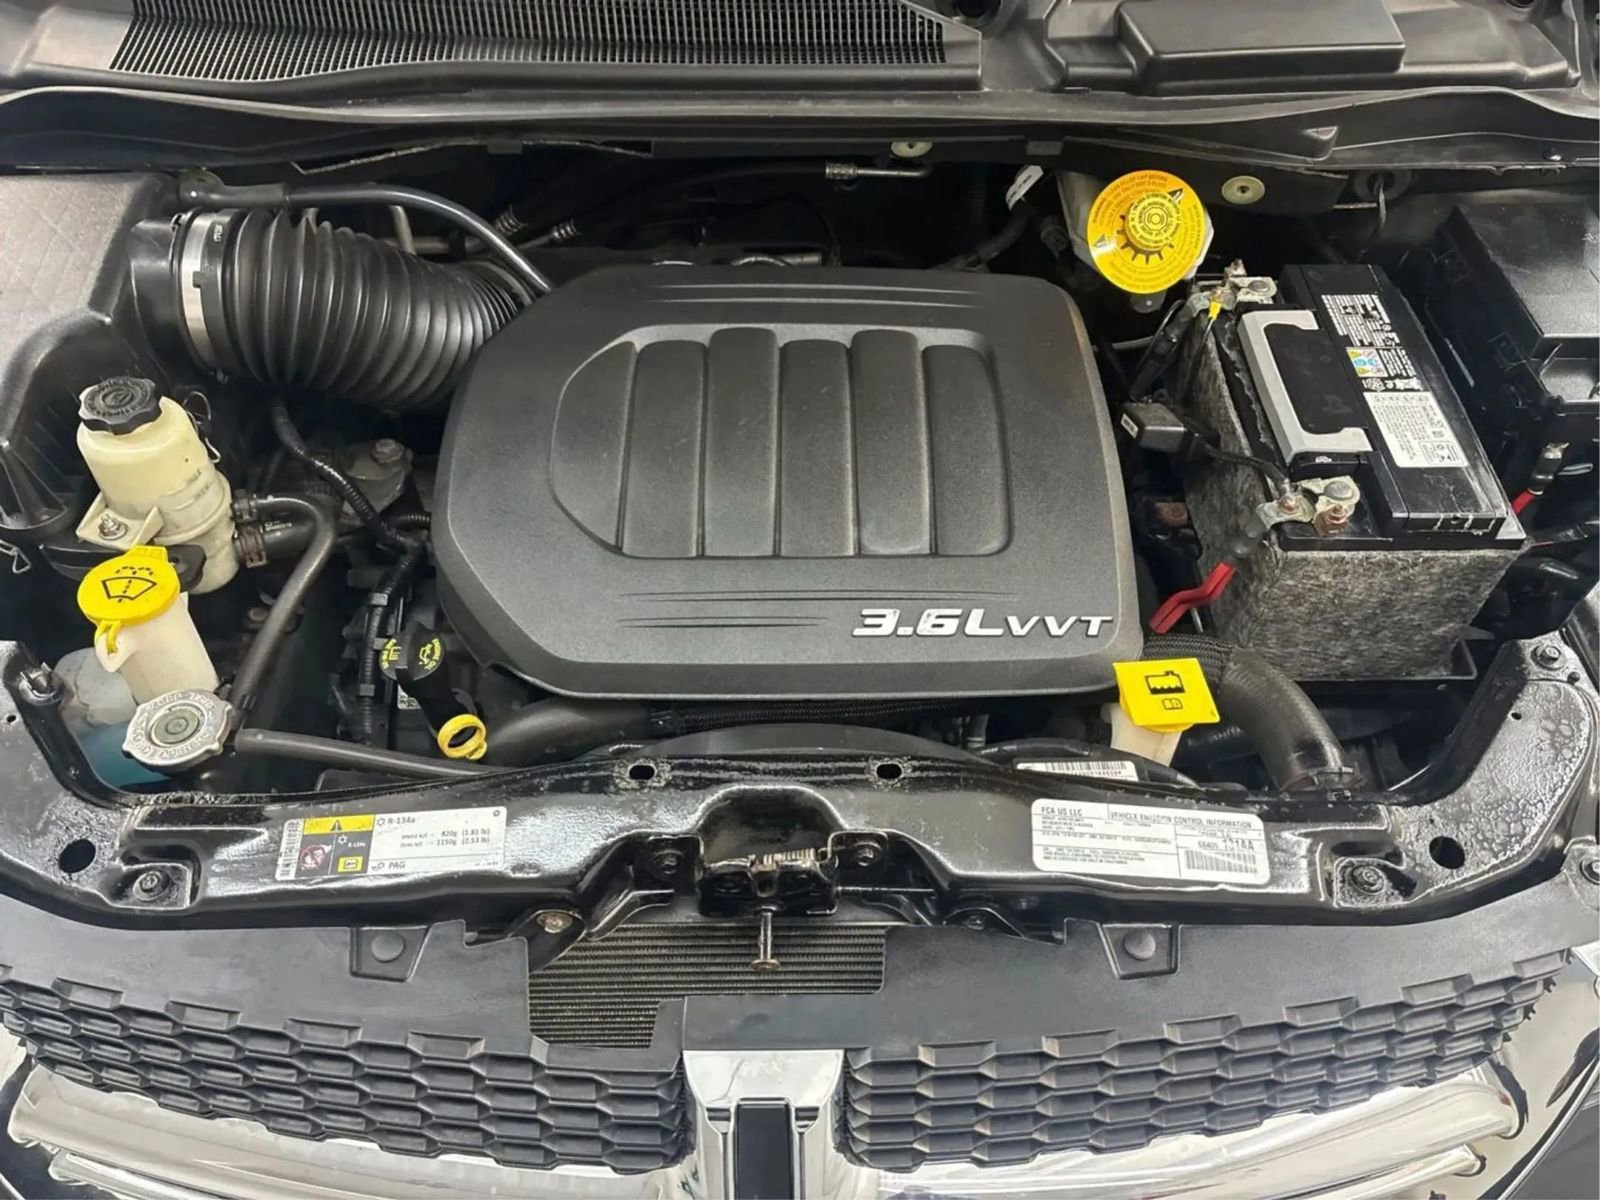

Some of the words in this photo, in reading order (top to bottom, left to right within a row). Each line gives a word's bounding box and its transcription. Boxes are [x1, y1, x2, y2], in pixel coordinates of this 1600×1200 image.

[1006, 615, 1114, 637] VVT
[1041, 806, 1055, 814] FCA
[387, 816, 416, 825] R-134a
[1111, 811, 1137, 821] VEHICLE
[1173, 816, 1204, 825] CONTROL
[1206, 818, 1252, 829] INFORMATION
[388, 861, 406, 870] PAG
